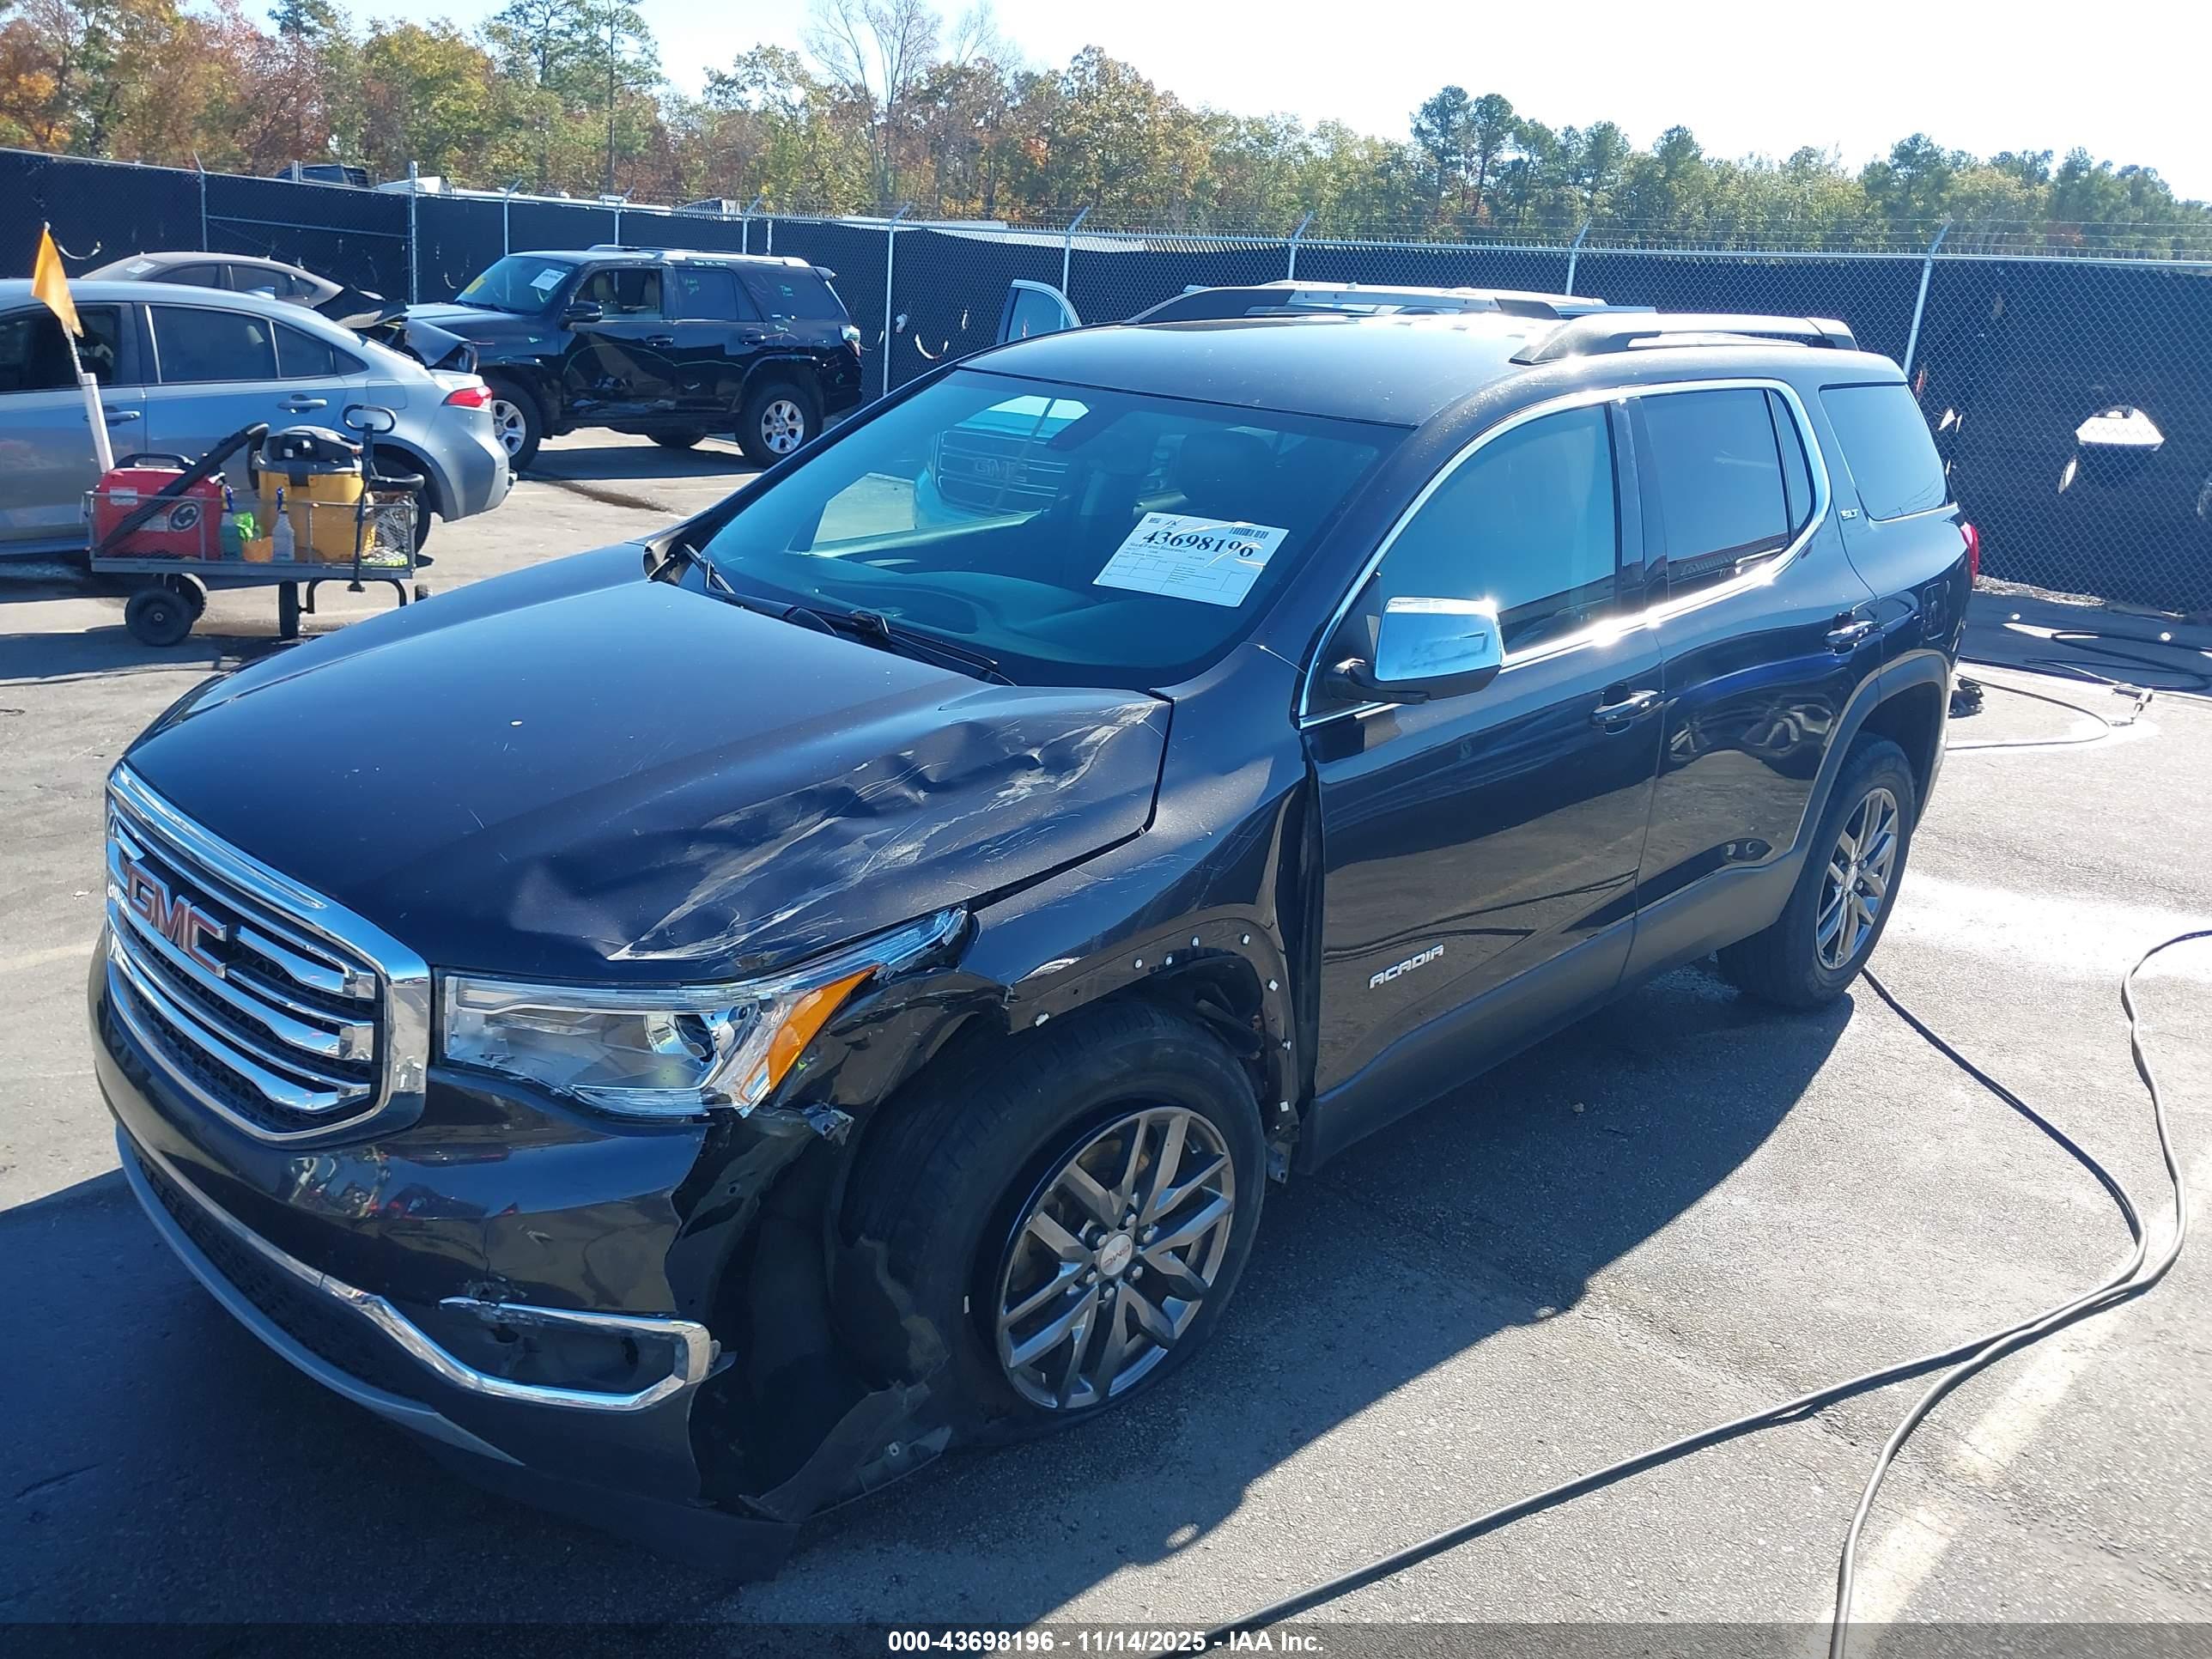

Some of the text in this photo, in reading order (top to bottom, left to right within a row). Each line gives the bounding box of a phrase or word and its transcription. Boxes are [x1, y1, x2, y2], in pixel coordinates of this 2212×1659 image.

[1840, 507, 1859, 520] SLT
[1143, 531, 1255, 557] 43698196
[127, 860, 228, 979] GMC
[1368, 944, 1444, 989] ACADIA
